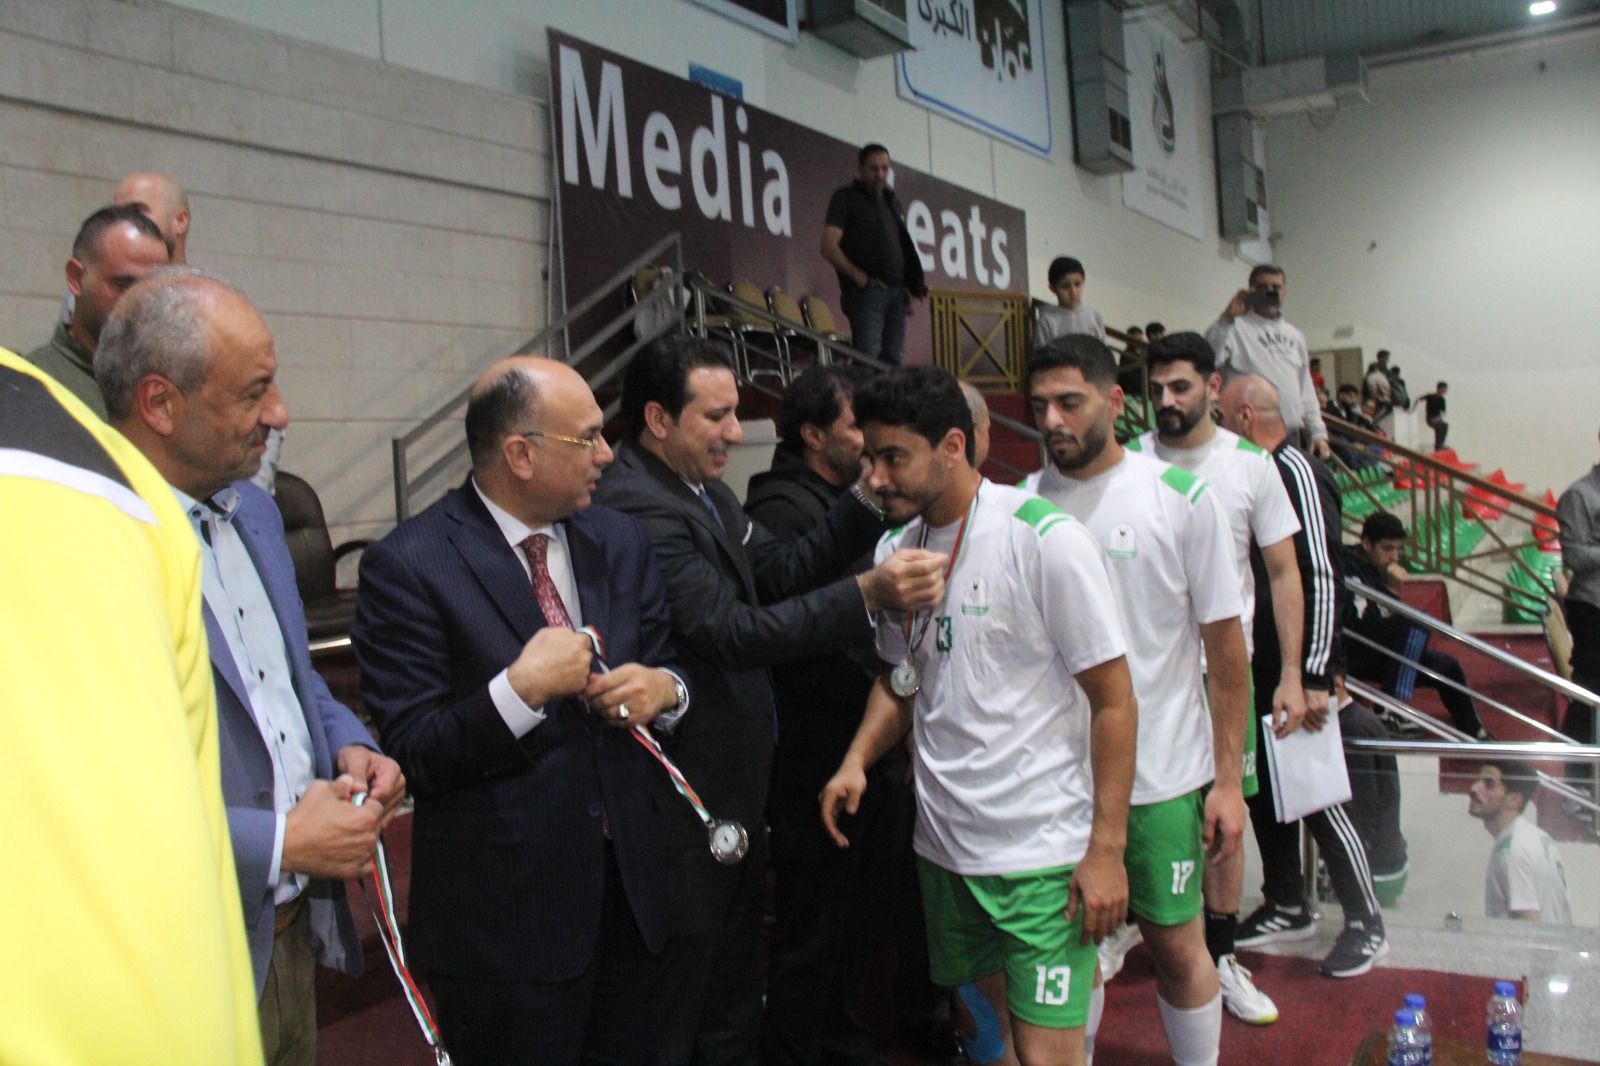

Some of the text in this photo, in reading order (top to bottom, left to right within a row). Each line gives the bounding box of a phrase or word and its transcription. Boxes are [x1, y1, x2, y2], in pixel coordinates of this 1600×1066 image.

[558, 43, 1011, 290] Media eats
[1034, 963, 1071, 1006] 13
